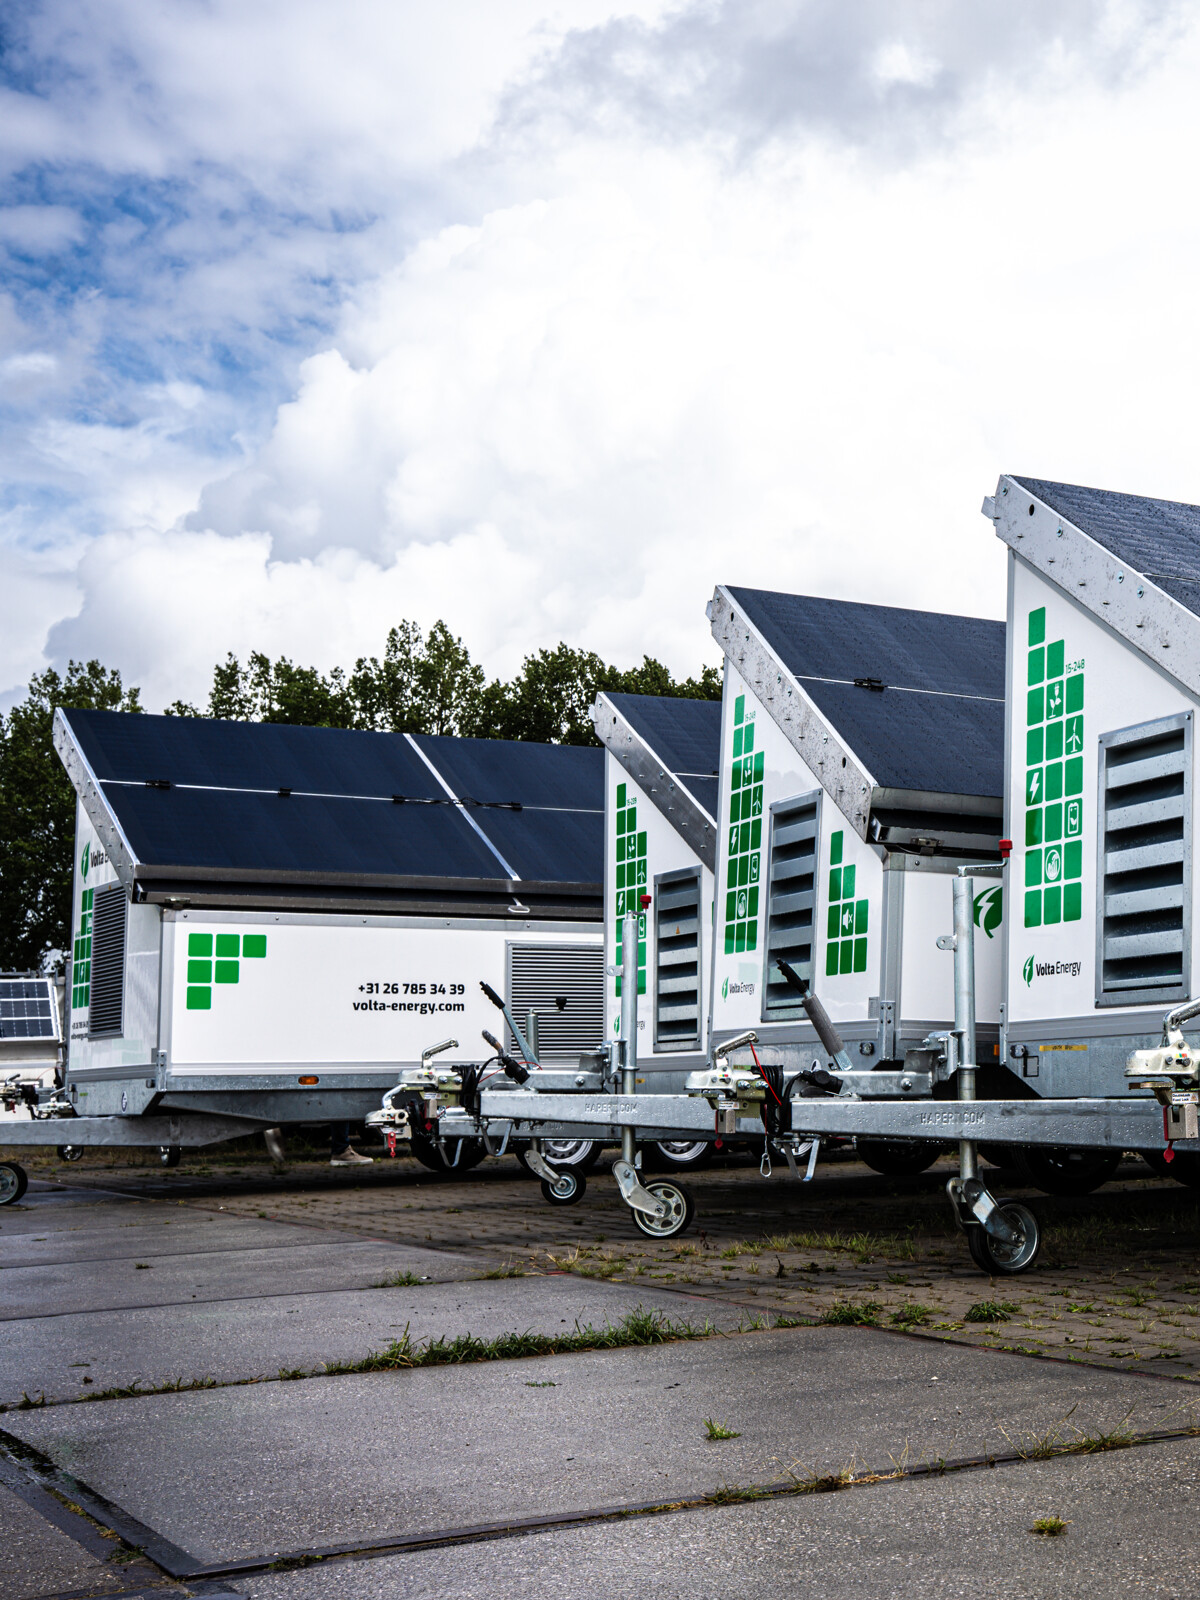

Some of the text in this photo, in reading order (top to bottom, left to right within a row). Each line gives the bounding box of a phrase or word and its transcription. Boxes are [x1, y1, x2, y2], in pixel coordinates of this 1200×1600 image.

[1065, 658, 1085, 674] 15-248
[90, 850, 104, 868] Volta
[1036, 961, 1081, 977] Volta Energy
[358, 983, 465, 995] +31 26 785 34 39
[729, 982, 755, 996] Volta Energy
[353, 1000, 465, 1015] volta-energy.com
